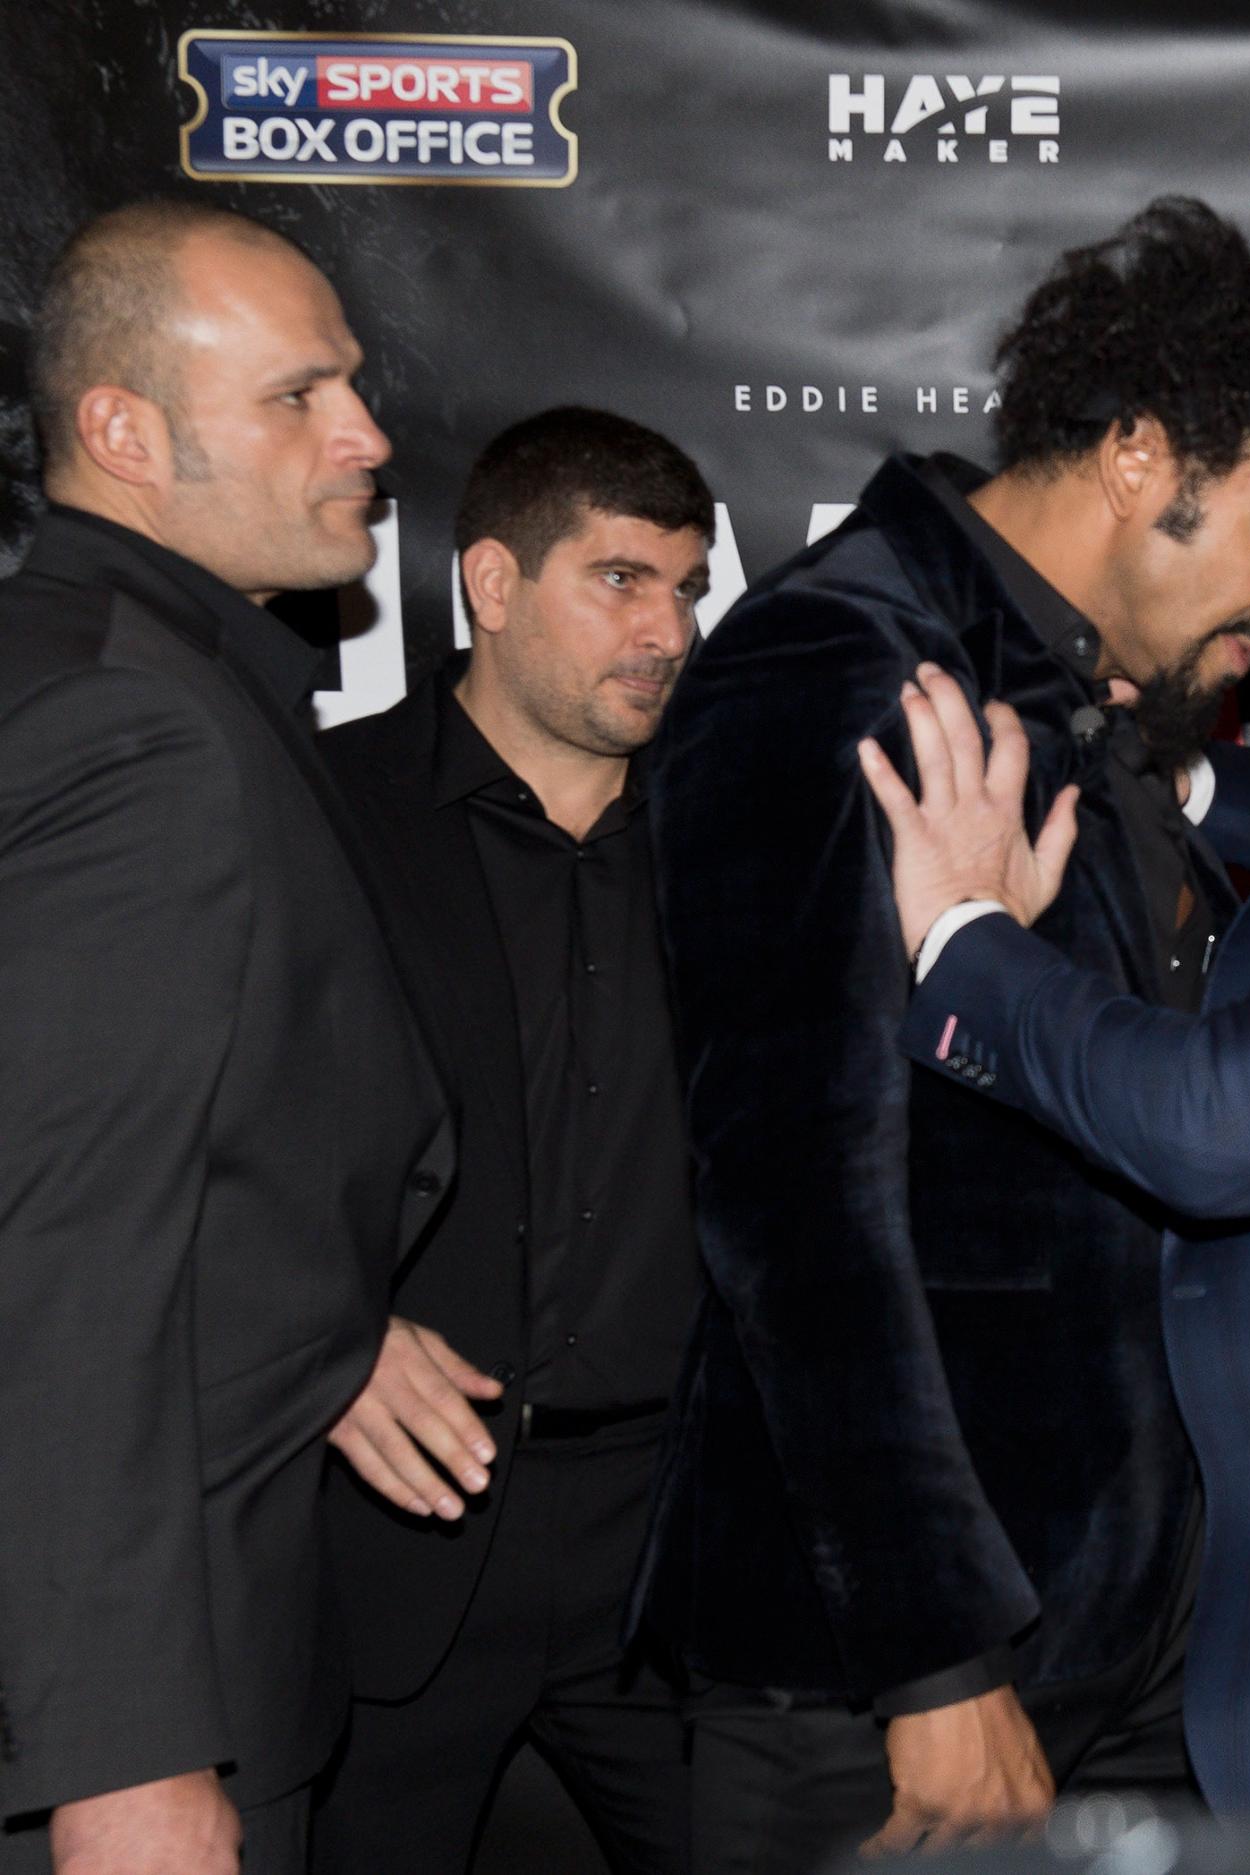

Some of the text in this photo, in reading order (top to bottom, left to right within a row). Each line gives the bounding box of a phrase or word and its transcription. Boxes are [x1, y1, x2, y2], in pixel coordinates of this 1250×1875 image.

[232, 56, 524, 107] sky SPORTS
[828, 73, 1060, 135] HAYE
[222, 116, 535, 165] BOX OFFICE
[828, 137, 1060, 163] MAKER
[734, 385, 878, 412] EDDIE
